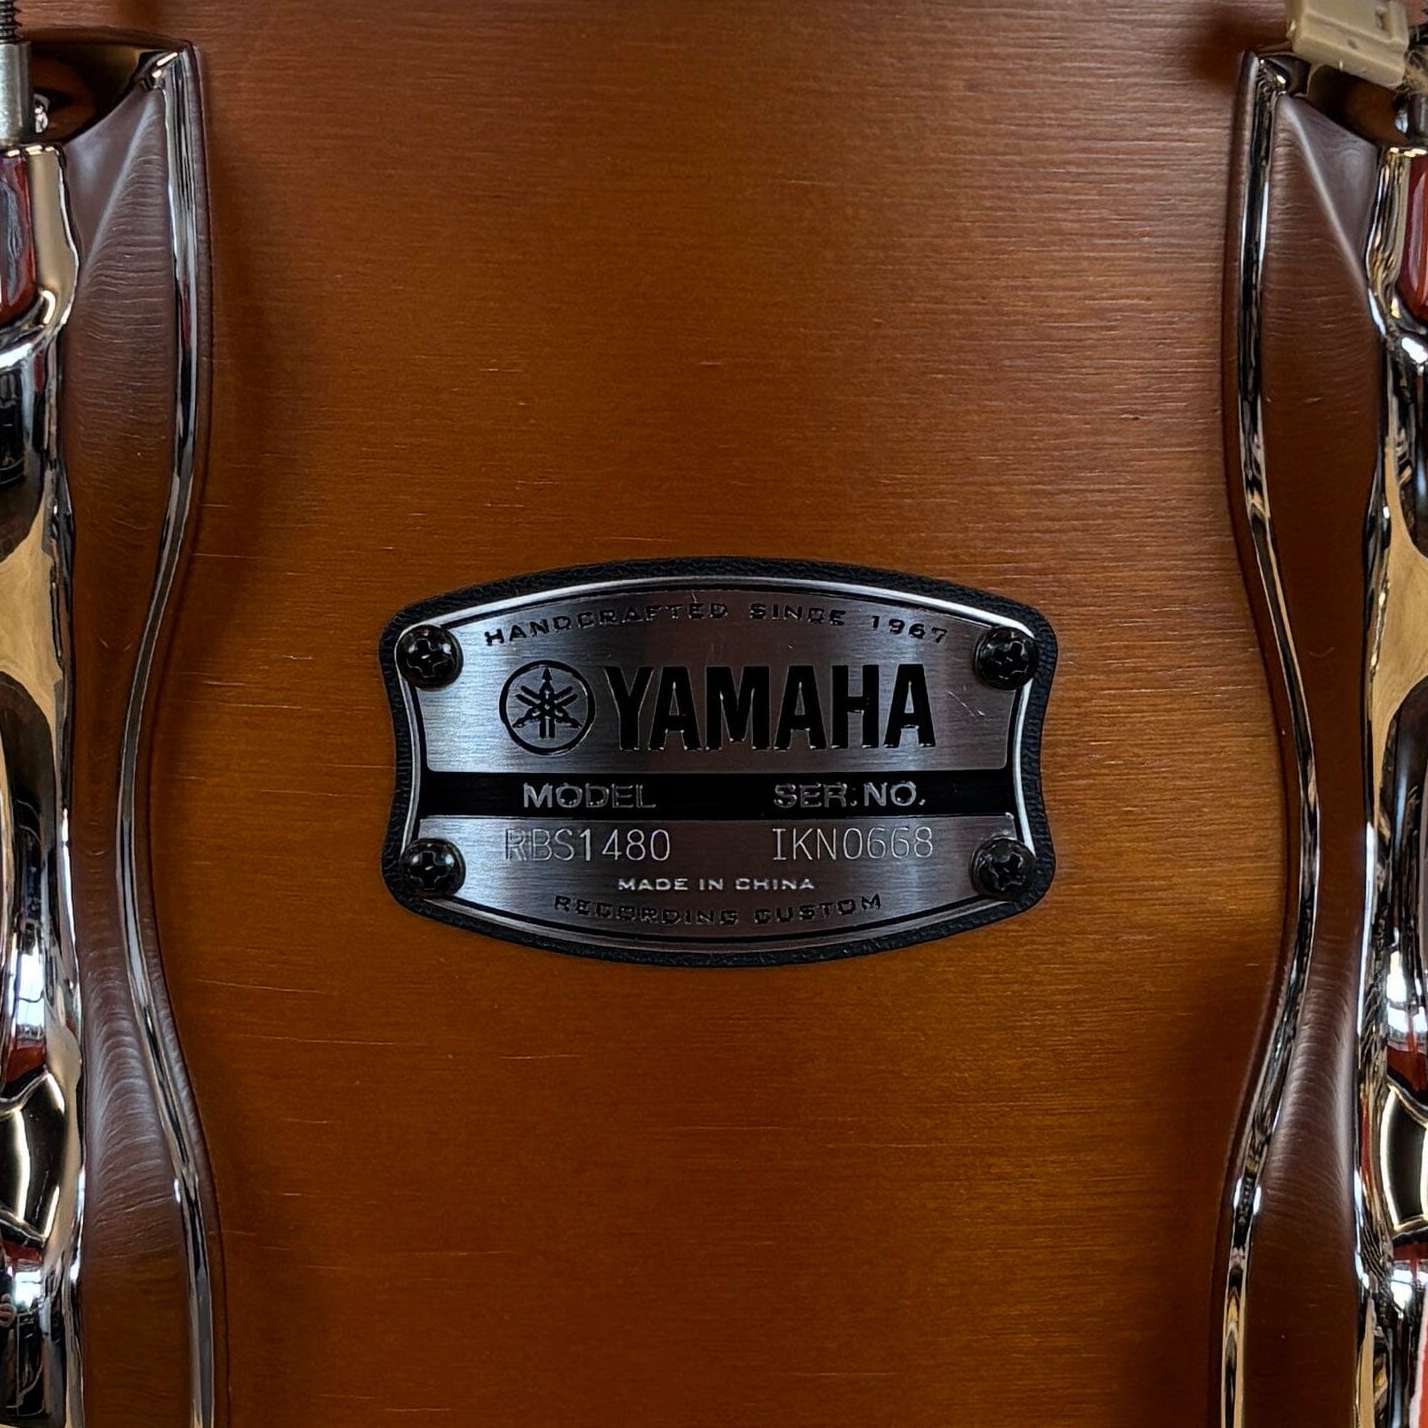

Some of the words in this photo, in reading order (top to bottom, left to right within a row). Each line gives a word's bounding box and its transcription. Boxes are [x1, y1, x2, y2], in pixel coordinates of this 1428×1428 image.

[484, 601, 729, 646] HANDCRAFTED
[749, 602, 847, 627] SINCE
[871, 614, 949, 645] 1967
[604, 664, 937, 752] YAMAHA
[522, 782, 657, 810] MODEL
[504, 827, 671, 863] RBS1480
[771, 826, 934, 861] IKN0668
[617, 877, 689, 891] MADE
[698, 877, 724, 891] IN
[734, 877, 816, 891] CHINA
[553, 894, 740, 926] RECORDING
[753, 892, 882, 926] CUSTOM
